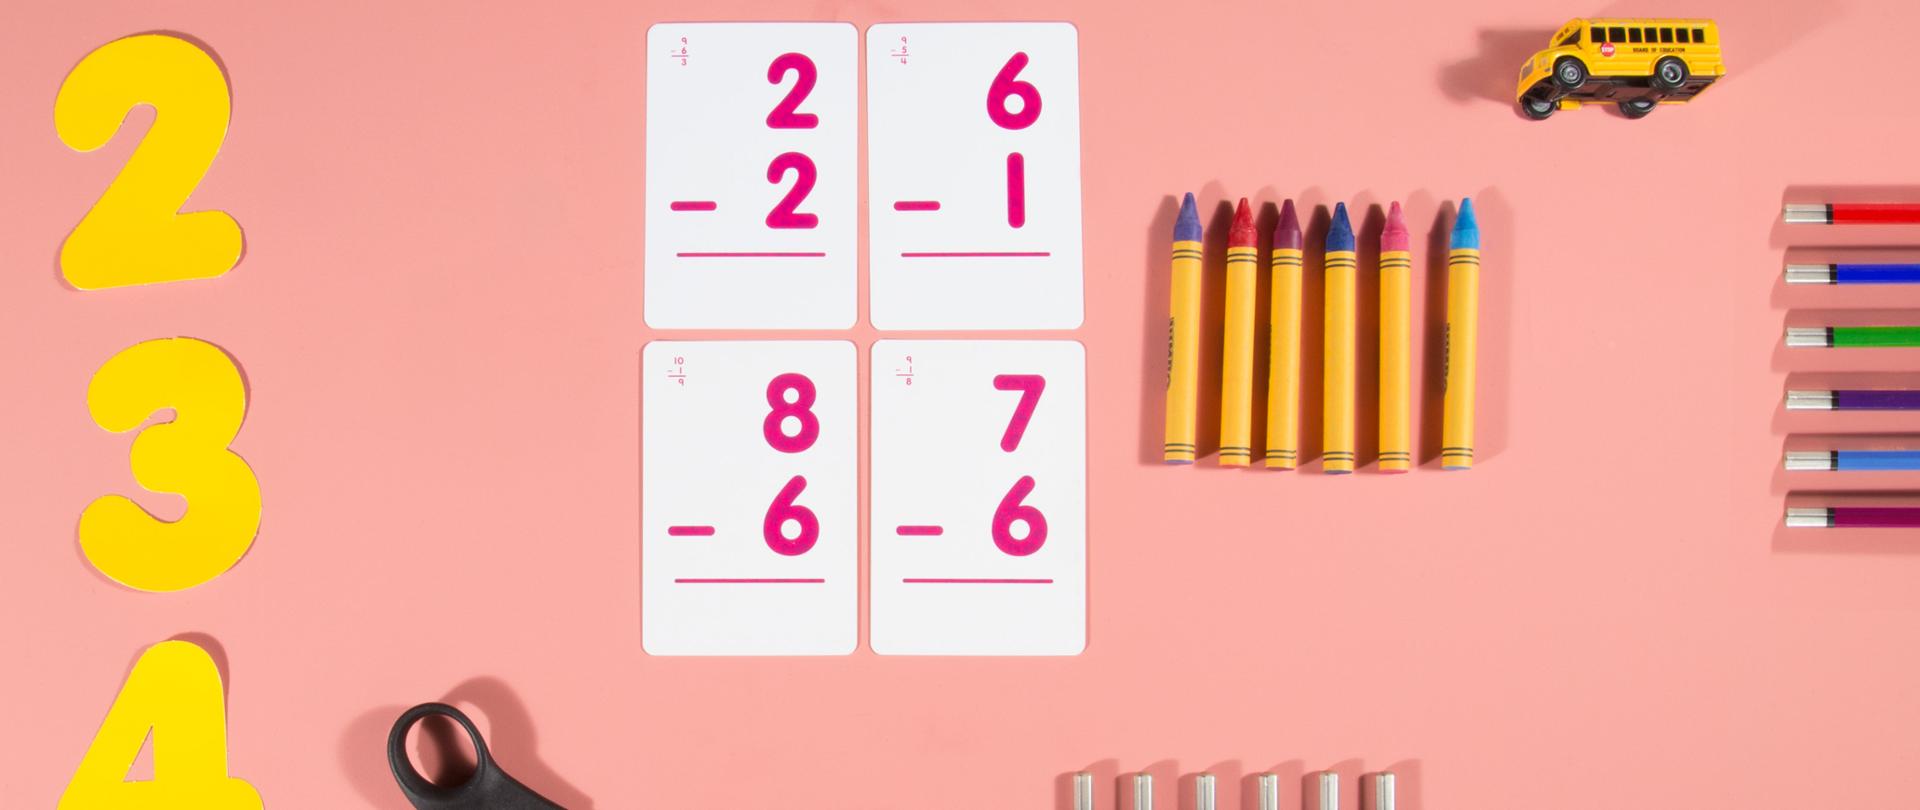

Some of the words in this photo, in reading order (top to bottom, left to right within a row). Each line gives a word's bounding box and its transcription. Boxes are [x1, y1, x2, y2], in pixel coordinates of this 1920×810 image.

[681, 37, 687, 45] 9
[681, 46, 687, 54] 6
[681, 58, 687, 66] 3
[901, 36, 907, 44] 9
[901, 46, 907, 54] 5
[901, 57, 907, 65] 4
[765, 52, 819, 129] 2
[986, 51, 1043, 131] 6
[55, 35, 241, 290] 2
[765, 151, 819, 230] 2
[1006, 152, 1026, 229] 1
[674, 356, 684, 365] 10
[678, 378, 684, 386] 9
[906, 356, 912, 364] 9
[763, 372, 820, 454] 8
[992, 374, 1046, 453] 7
[79, 338, 262, 592] 3
[763, 475, 820, 557] 6
[991, 475, 1048, 557] 6
[57, 640, 263, 810] 4
